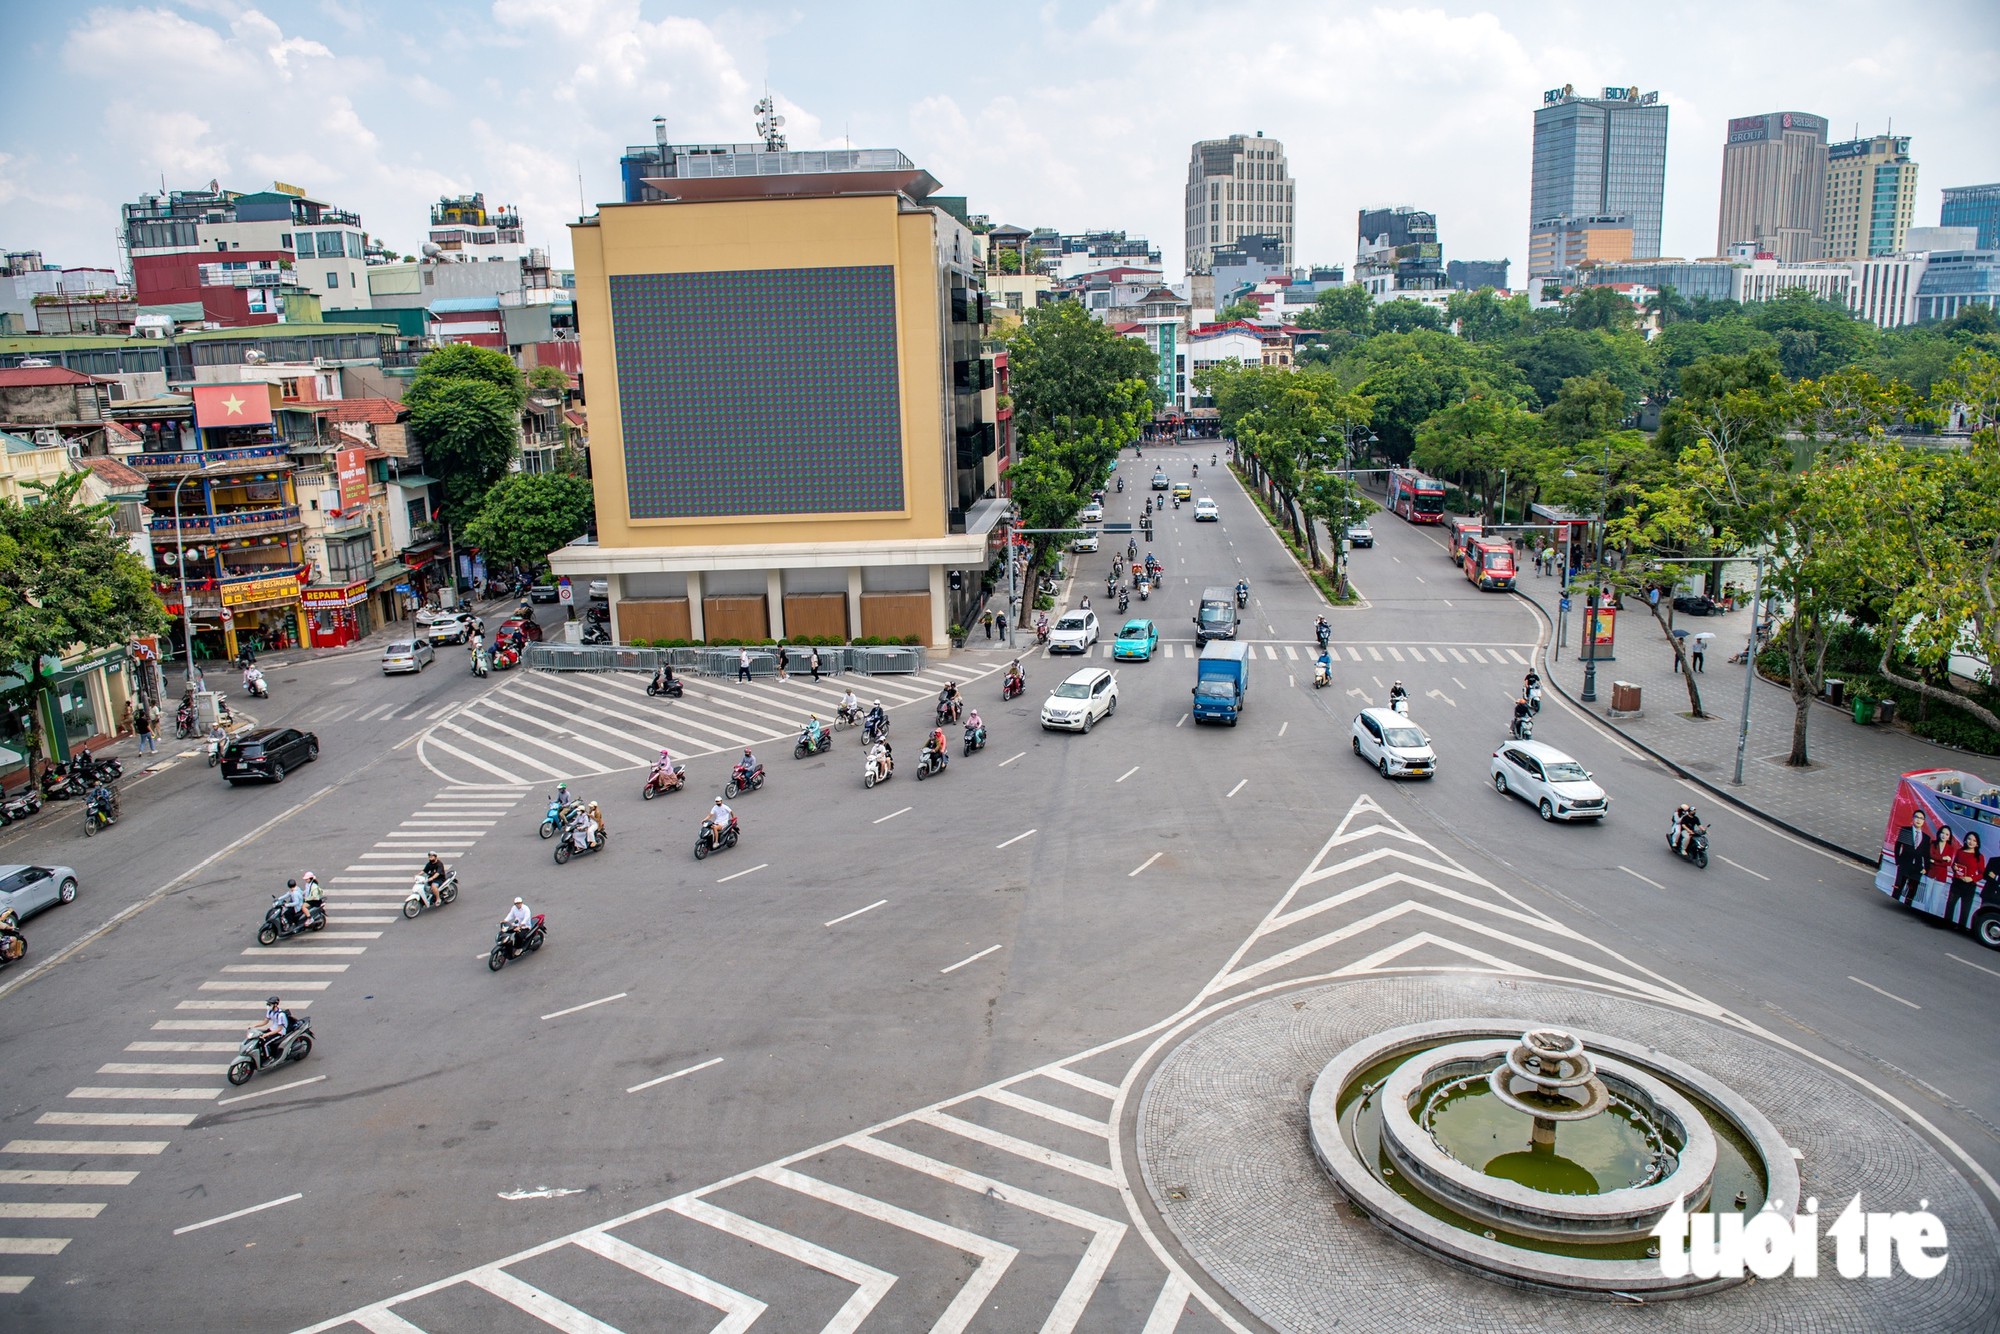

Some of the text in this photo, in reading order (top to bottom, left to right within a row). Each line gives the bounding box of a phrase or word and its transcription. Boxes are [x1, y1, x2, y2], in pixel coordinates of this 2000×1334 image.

[1544, 87, 1565, 103] BIDV
[1605, 87, 1630, 100] BIDV
[1730, 130, 1763, 142] GROUP
[240, 582, 262, 592] SQARE
[263, 577, 297, 588] RESTAURANT
[307, 591, 340, 600] REPAIR
[133, 641, 155, 659] SPA
[75, 657, 107, 673] Vietcombank
[109, 663, 119, 672] ATM
